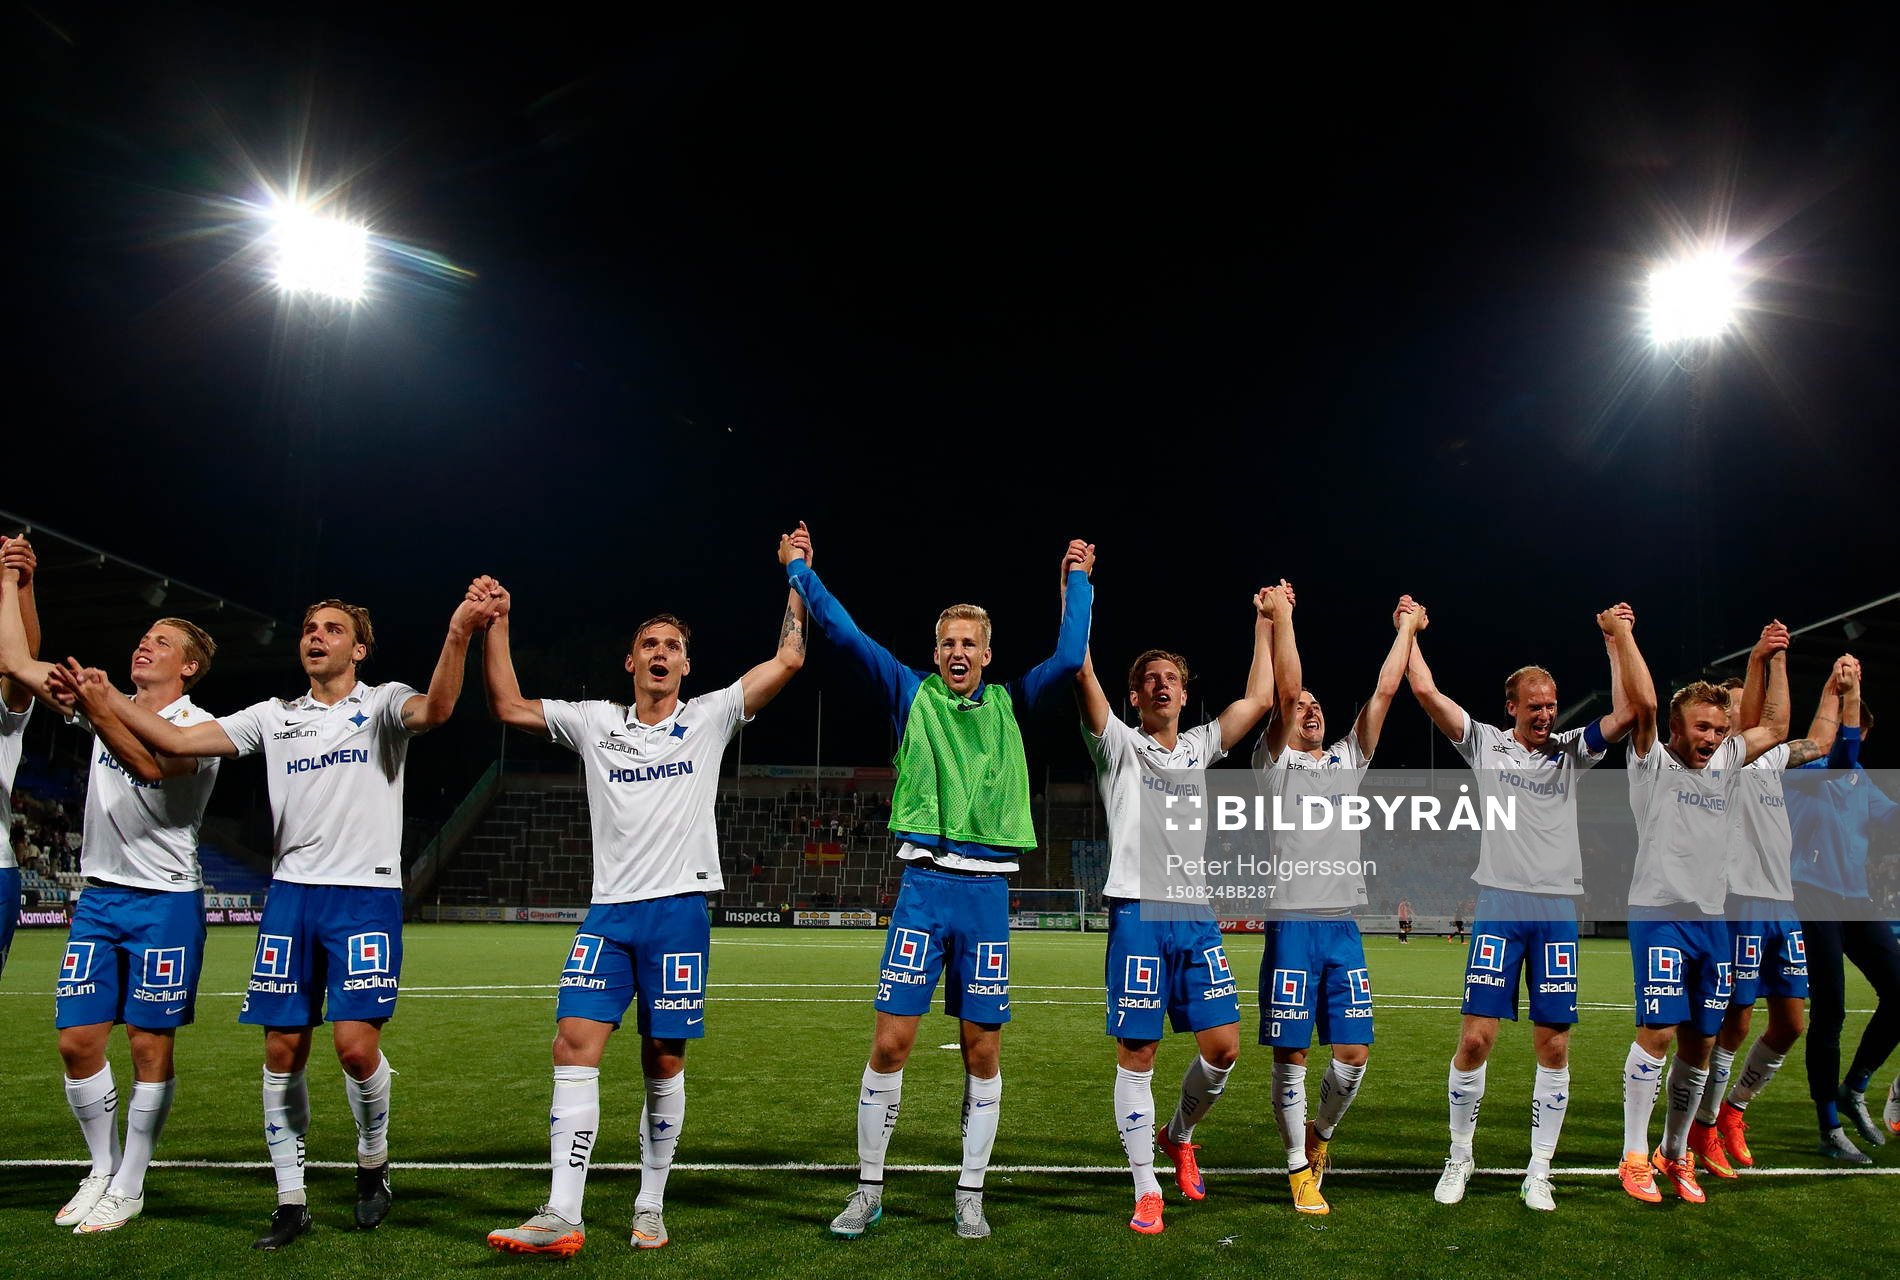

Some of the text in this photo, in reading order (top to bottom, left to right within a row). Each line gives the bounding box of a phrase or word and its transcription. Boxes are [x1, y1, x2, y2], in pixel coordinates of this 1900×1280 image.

[598, 741, 639, 756] stadium
[287, 749, 368, 774] HOLMEN
[609, 761, 694, 783] HOLMEN
[1142, 776, 1200, 796] HOLMEN
[1499, 770, 1565, 795] HOLMEN
[725, 911, 781, 924] Inspecta
[1046, 917, 1073, 927] SEB
[343, 975, 398, 991] stadium
[881, 968, 927, 985] stadium
[1466, 973, 1506, 988] stadium
[133, 987, 188, 1002] stadium
[878, 983, 892, 1001] 25
[1117, 996, 1161, 1009] stadium
[1644, 998, 1659, 1015] 14
[1117, 1011, 1126, 1027] 7
[1265, 1008, 1309, 1020] stadium
[569, 1130, 594, 1171] SITA
